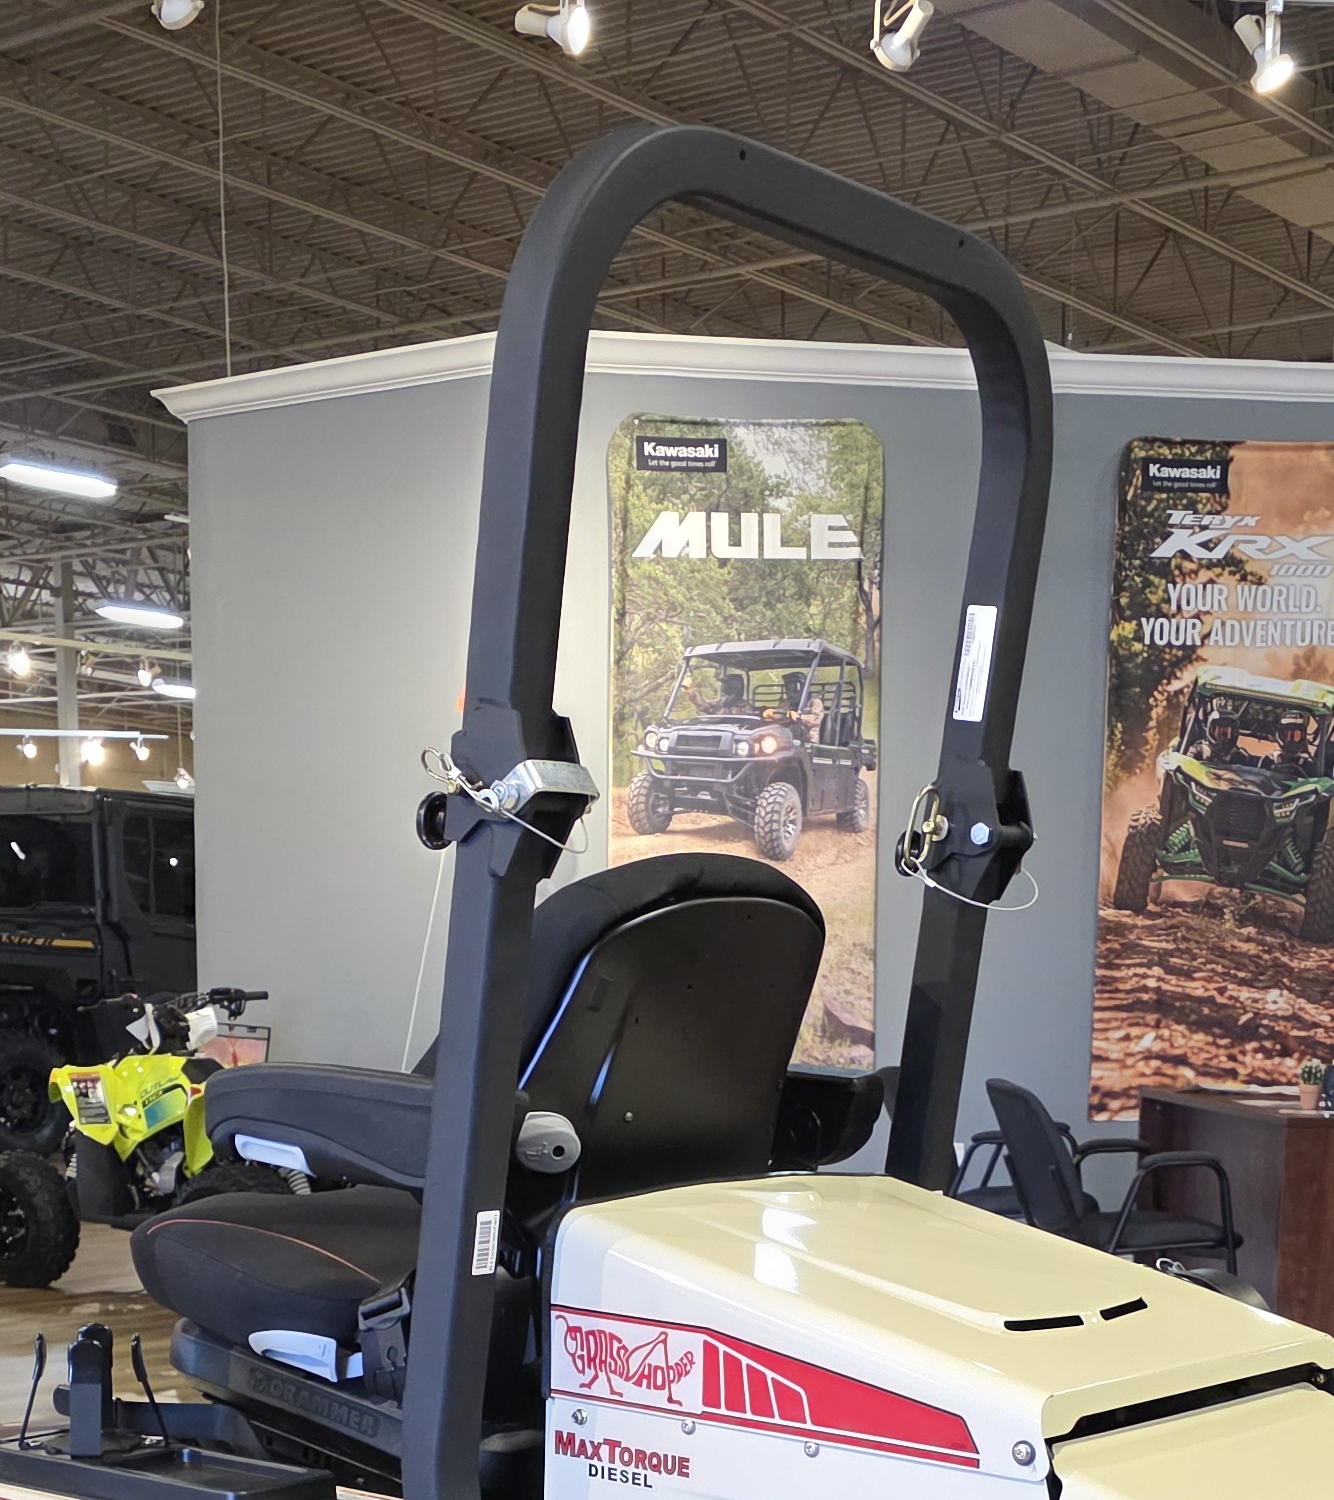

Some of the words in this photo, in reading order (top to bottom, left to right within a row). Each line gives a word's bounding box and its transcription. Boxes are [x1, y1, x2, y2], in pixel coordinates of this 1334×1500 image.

[643, 441, 719, 458] Kawasaki
[1149, 463, 1221, 479] Kawasaki
[1166, 509, 1262, 529] TERYX
[631, 510, 865, 560] MULE
[1269, 563, 1334, 578] 1000
[1167, 583, 1228, 612] YOUR
[1236, 585, 1322, 613] WORLD.
[1140, 617, 1202, 647] YOUR
[563, 1323, 696, 1400] GRASSHOPPER
[270, 1379, 377, 1435] GRAMMER
[588, 1463, 653, 1489] DIESEL
